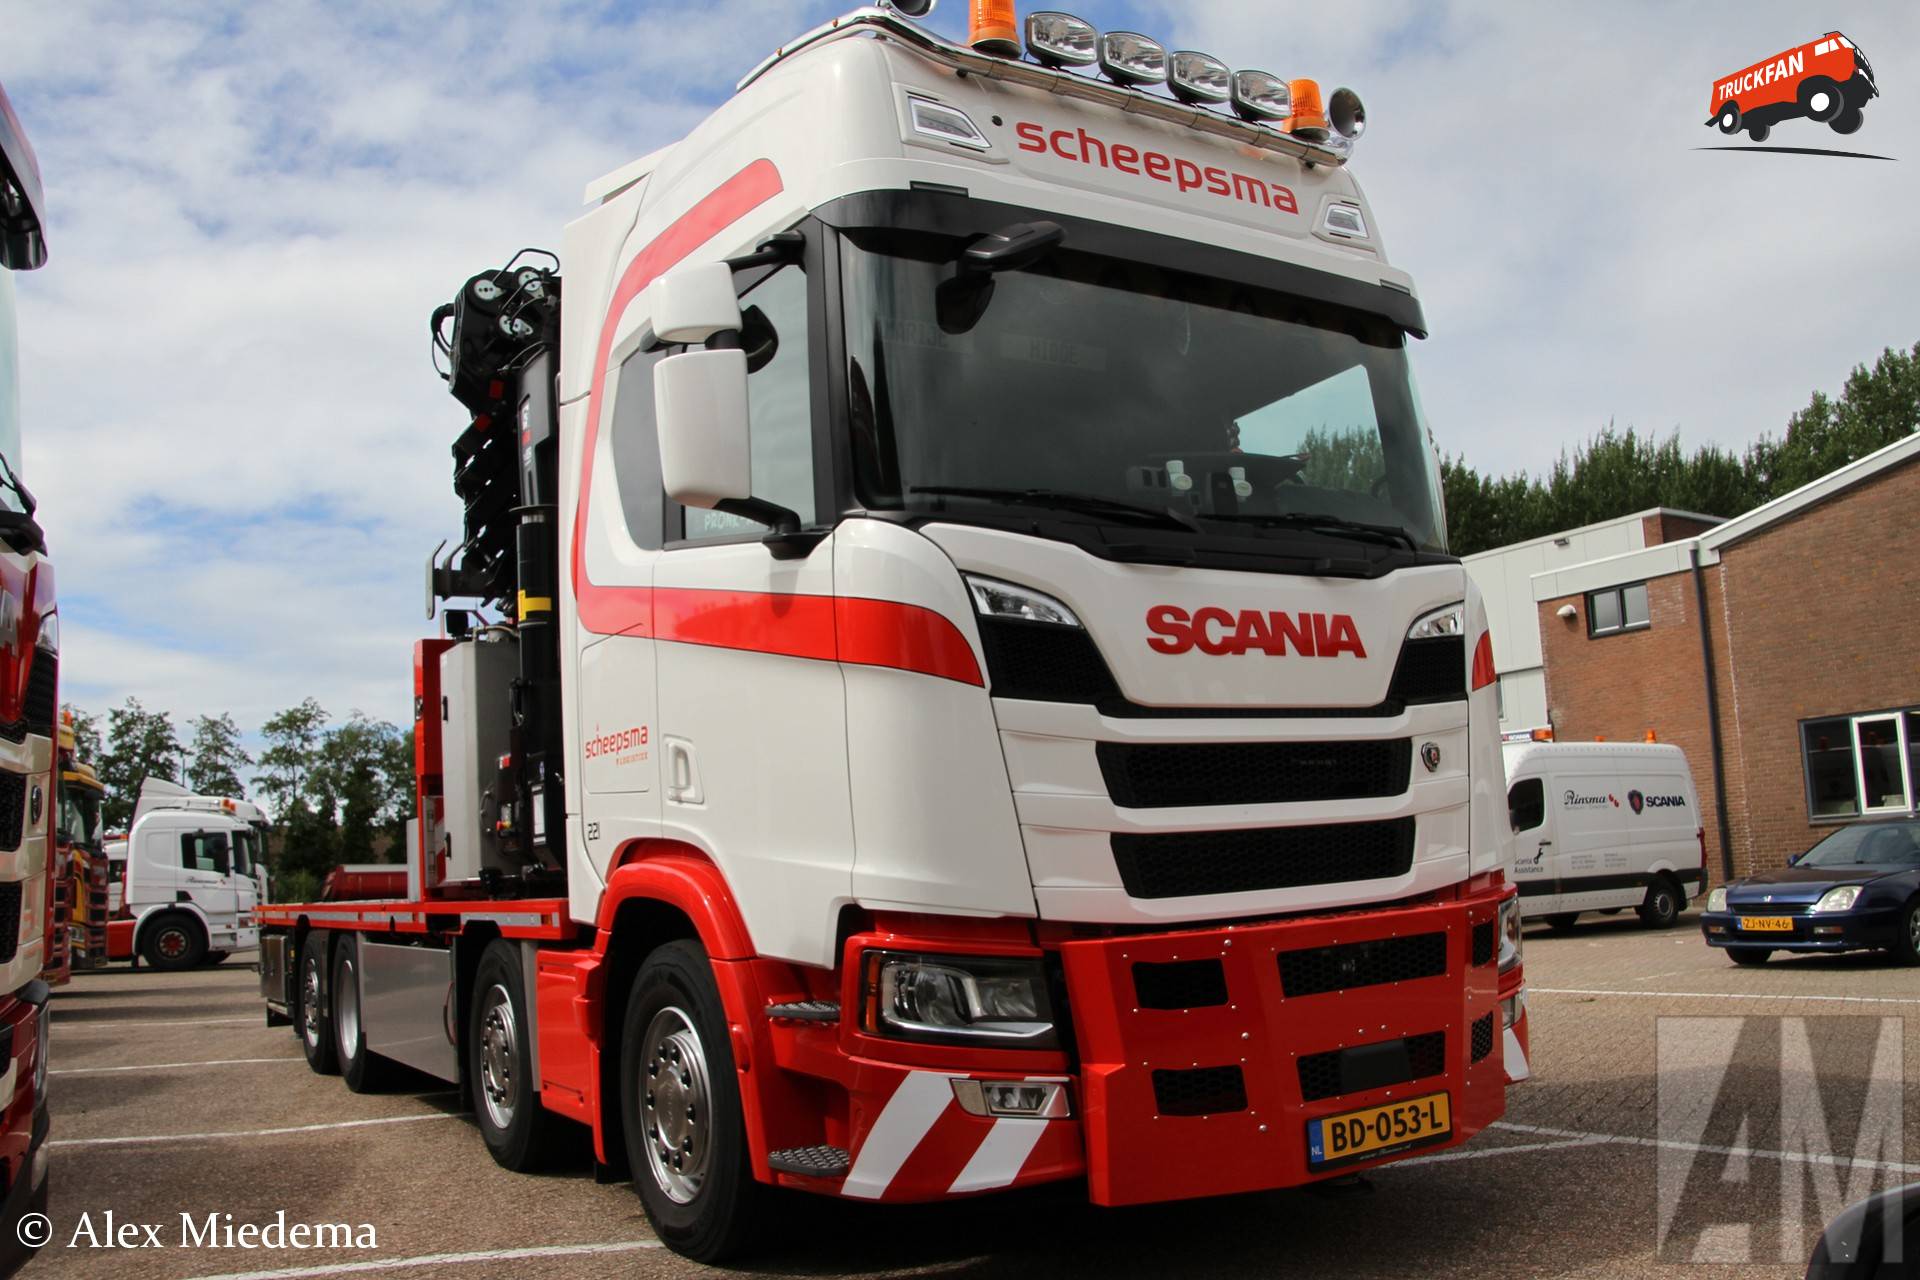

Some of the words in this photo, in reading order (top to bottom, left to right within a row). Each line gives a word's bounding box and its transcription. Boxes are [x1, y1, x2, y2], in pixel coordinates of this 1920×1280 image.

[1015, 121, 1299, 216] scheepsma
[1146, 604, 1367, 659] SCANIA
[585, 722, 648, 762] scheepsma
[1646, 795, 1686, 807] SCANIA
[1311, 1146, 1323, 1157] NL
[1331, 1101, 1443, 1152] BD-053-L
